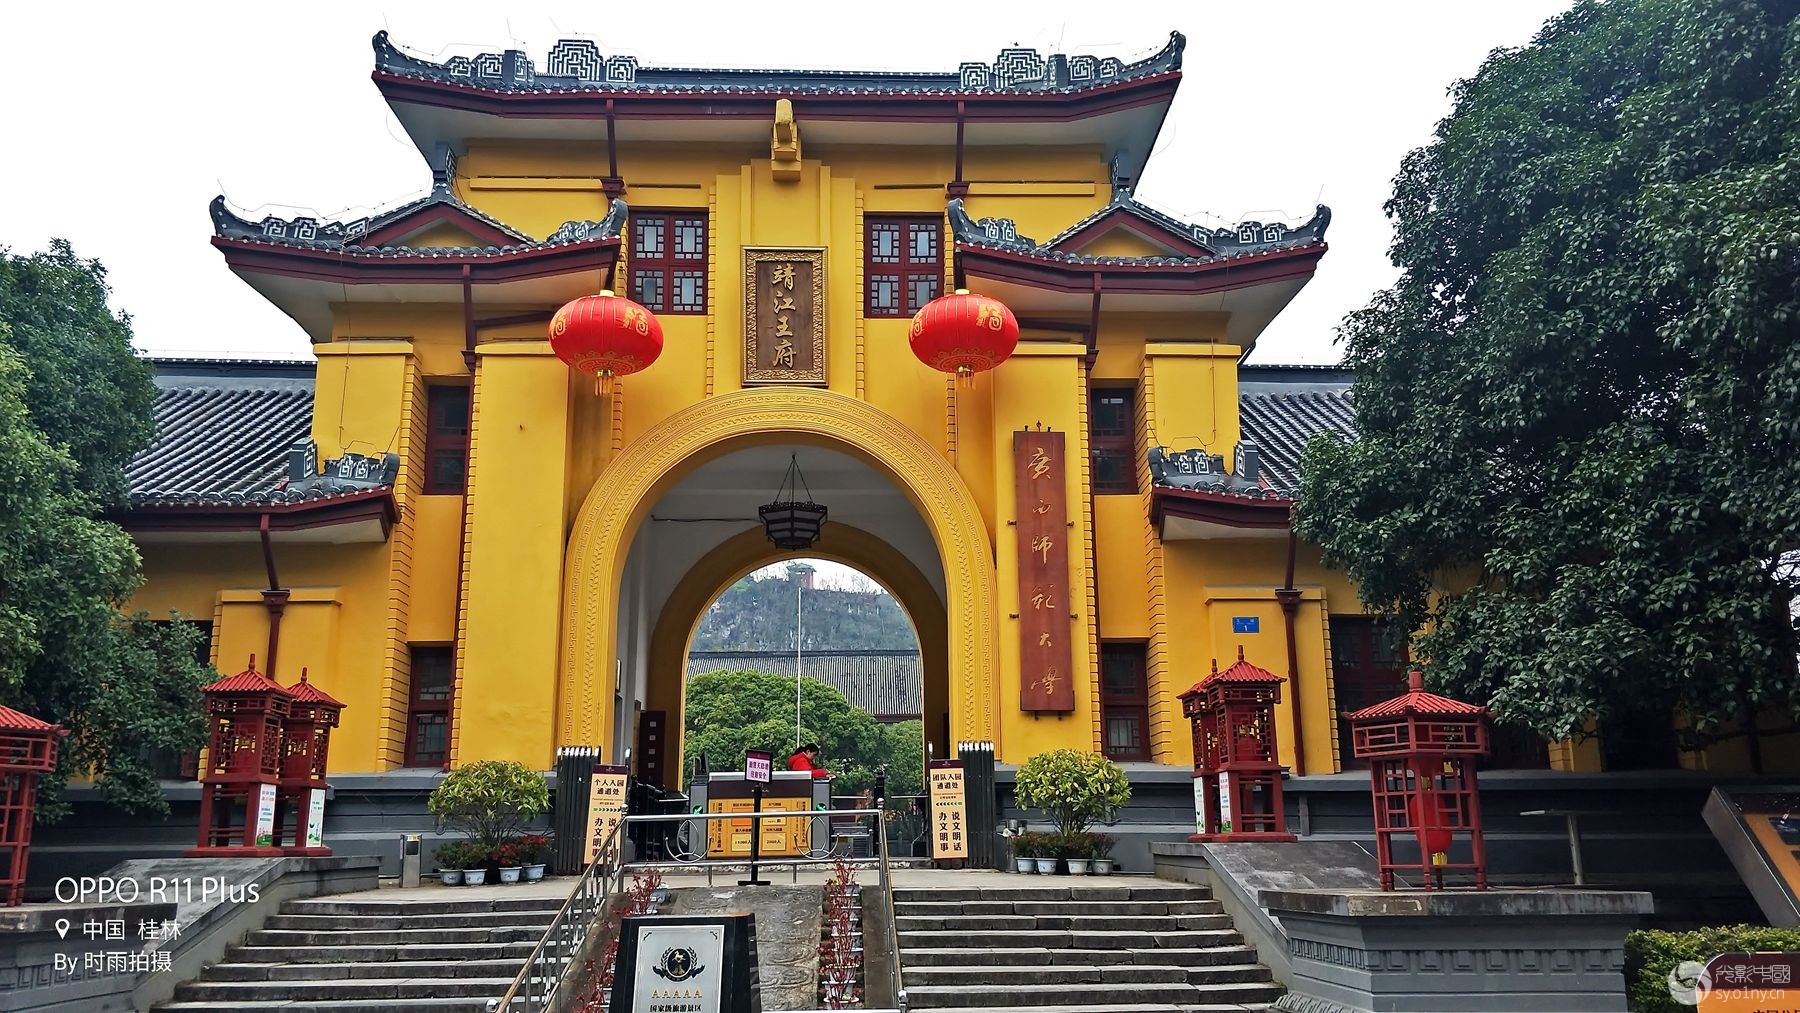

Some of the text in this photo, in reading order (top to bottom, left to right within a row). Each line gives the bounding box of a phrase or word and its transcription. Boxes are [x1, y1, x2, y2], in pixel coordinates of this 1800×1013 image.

[771, 263, 797, 368] 靖江王府
[594, 778, 625, 787] 个人入园
[932, 773, 961, 781] 团队入园
[596, 787, 620, 796] 通道处
[938, 811, 949, 852] 办文明事
[951, 811, 962, 851] 说文明话
[651, 984, 703, 999] AAAAA
[650, 1004, 702, 1013] 国家级旅游景区
